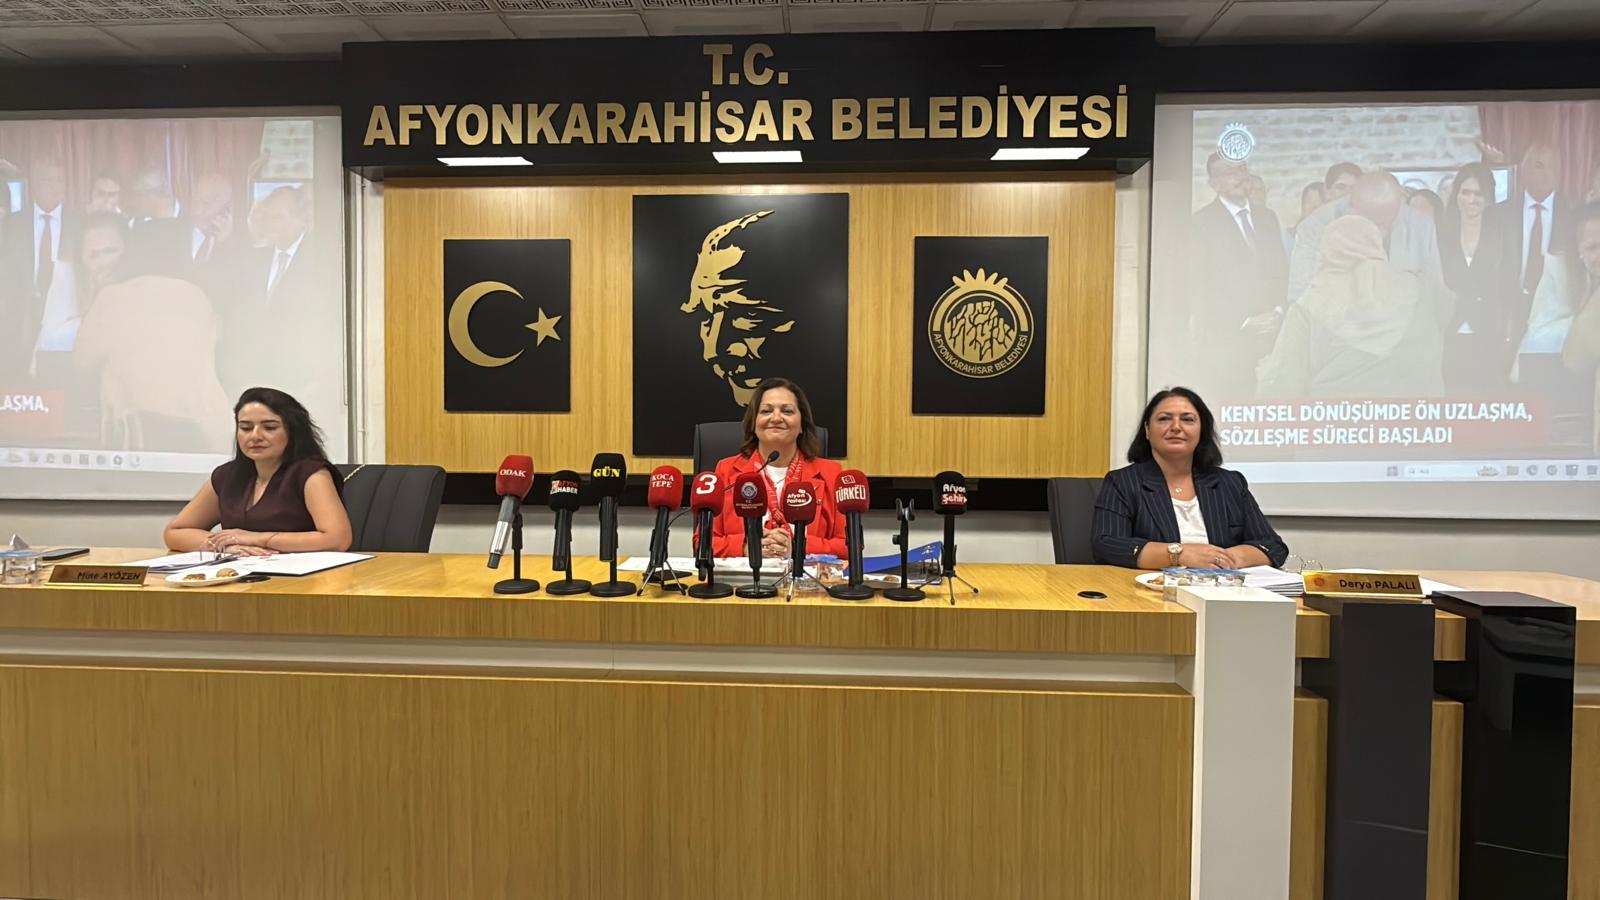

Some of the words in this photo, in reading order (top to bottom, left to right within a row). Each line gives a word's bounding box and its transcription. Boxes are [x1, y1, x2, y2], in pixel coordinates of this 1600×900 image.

[703, 43, 789, 86] T.C.
[363, 91, 814, 146] AFYONKARAHİSAR
[832, 84, 1128, 140] BELEDİYESİ
[933, 333, 994, 374] AFYONKARAHİSAR
[0, 394, 49, 413] AŞMA,
[1220, 405, 1297, 423] KENTSEL
[1300, 401, 1411, 424] DÖNÜŞÜMDE
[1415, 400, 1441, 420] ÖN
[1445, 402, 1533, 422] UZLAŞMA,
[1220, 426, 1309, 447] SÖZLEŞME
[1313, 424, 1374, 444] SÜRECİ
[1378, 427, 1453, 446] BAŞLADI
[500, 469, 527, 478] ODAK
[593, 466, 620, 478] GÜN
[652, 473, 674, 481] KOCA
[651, 480, 672, 488] TEPE
[696, 474, 717, 494] 3
